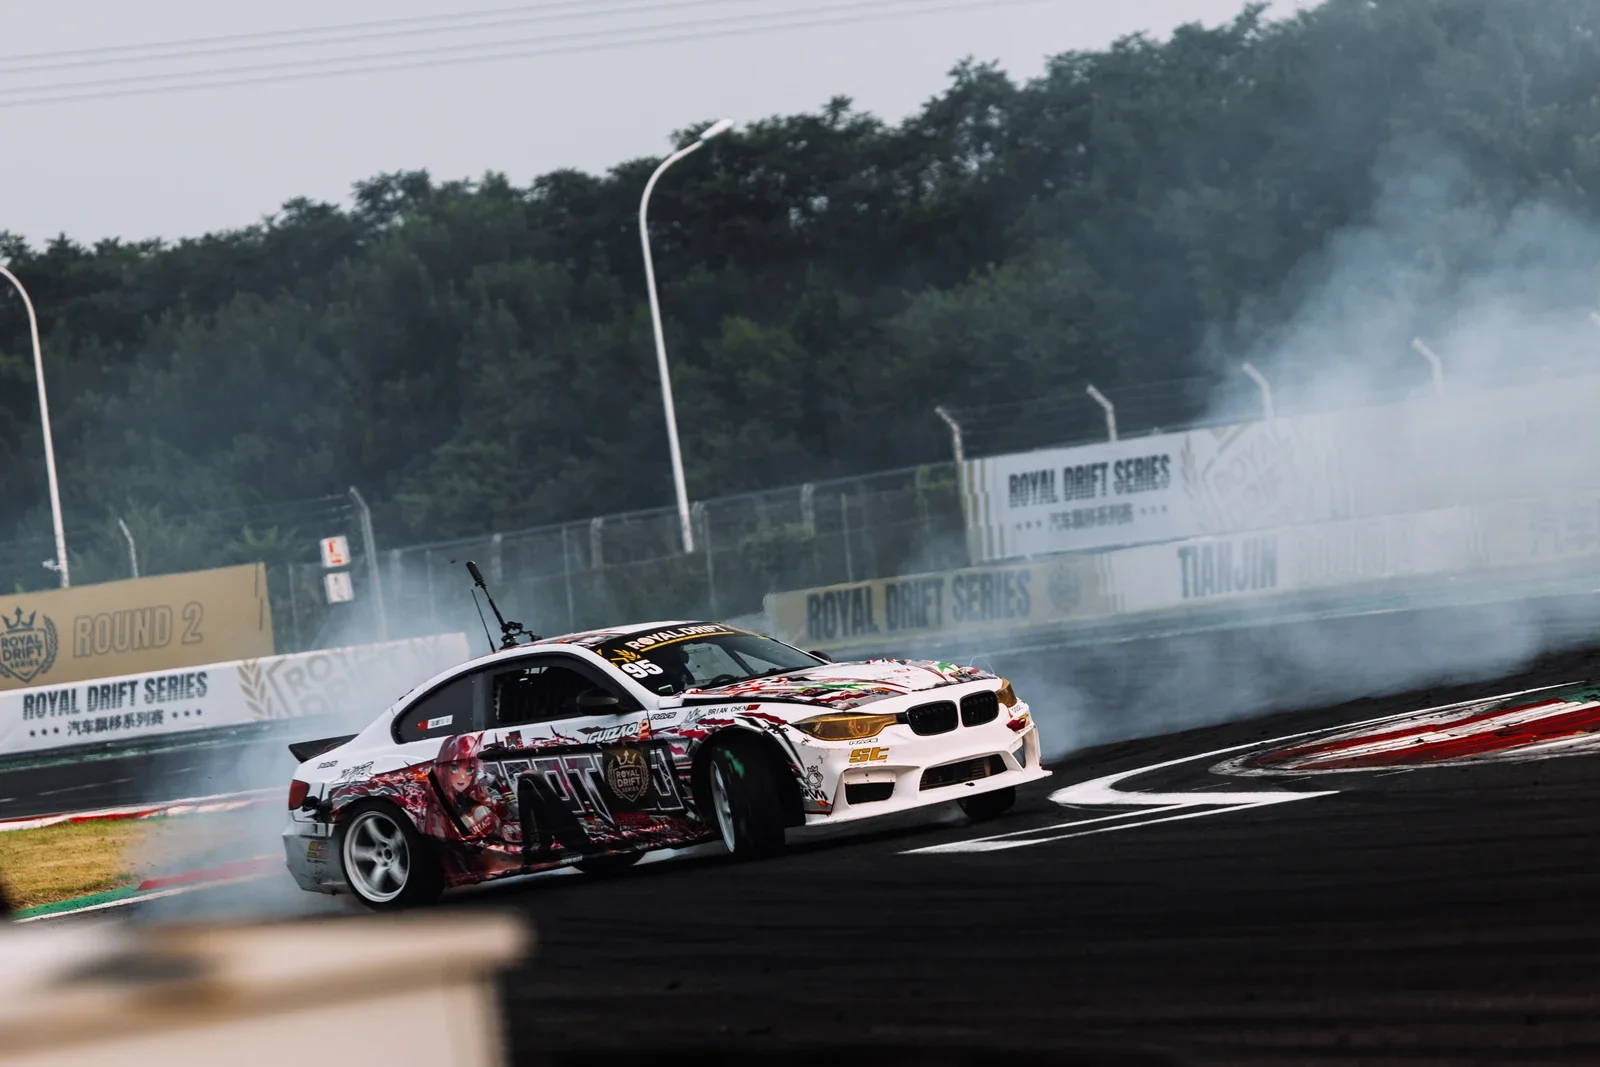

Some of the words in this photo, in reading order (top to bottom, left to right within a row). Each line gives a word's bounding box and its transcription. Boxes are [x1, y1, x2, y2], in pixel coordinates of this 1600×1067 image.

[1008, 468, 1059, 508] ROYAL
[1063, 462, 1109, 501] DRIFT
[1113, 453, 1171, 496] SERIES
[1178, 536, 1278, 599] TIANJIN
[806, 585, 880, 641] ROYAL
[885, 577, 945, 630] DRIFT
[951, 569, 1032, 623] SERIES
[73, 604, 173, 659] ROUND
[181, 601, 204, 645] 2
[1, 634, 42, 649] ROYAL
[2, 642, 43, 662] DRIFT
[9, 659, 40, 668] SERIES
[621, 659, 664, 679] 95
[22, 688, 80, 720] ROYAL
[87, 680, 138, 712] DRIFT
[144, 671, 207, 705] SERIES
[651, 711, 677, 720] RAYS
[707, 707, 729, 716] BRIAN
[616, 769, 640, 779] ROYAL
[617, 777, 641, 788] DRIFT
